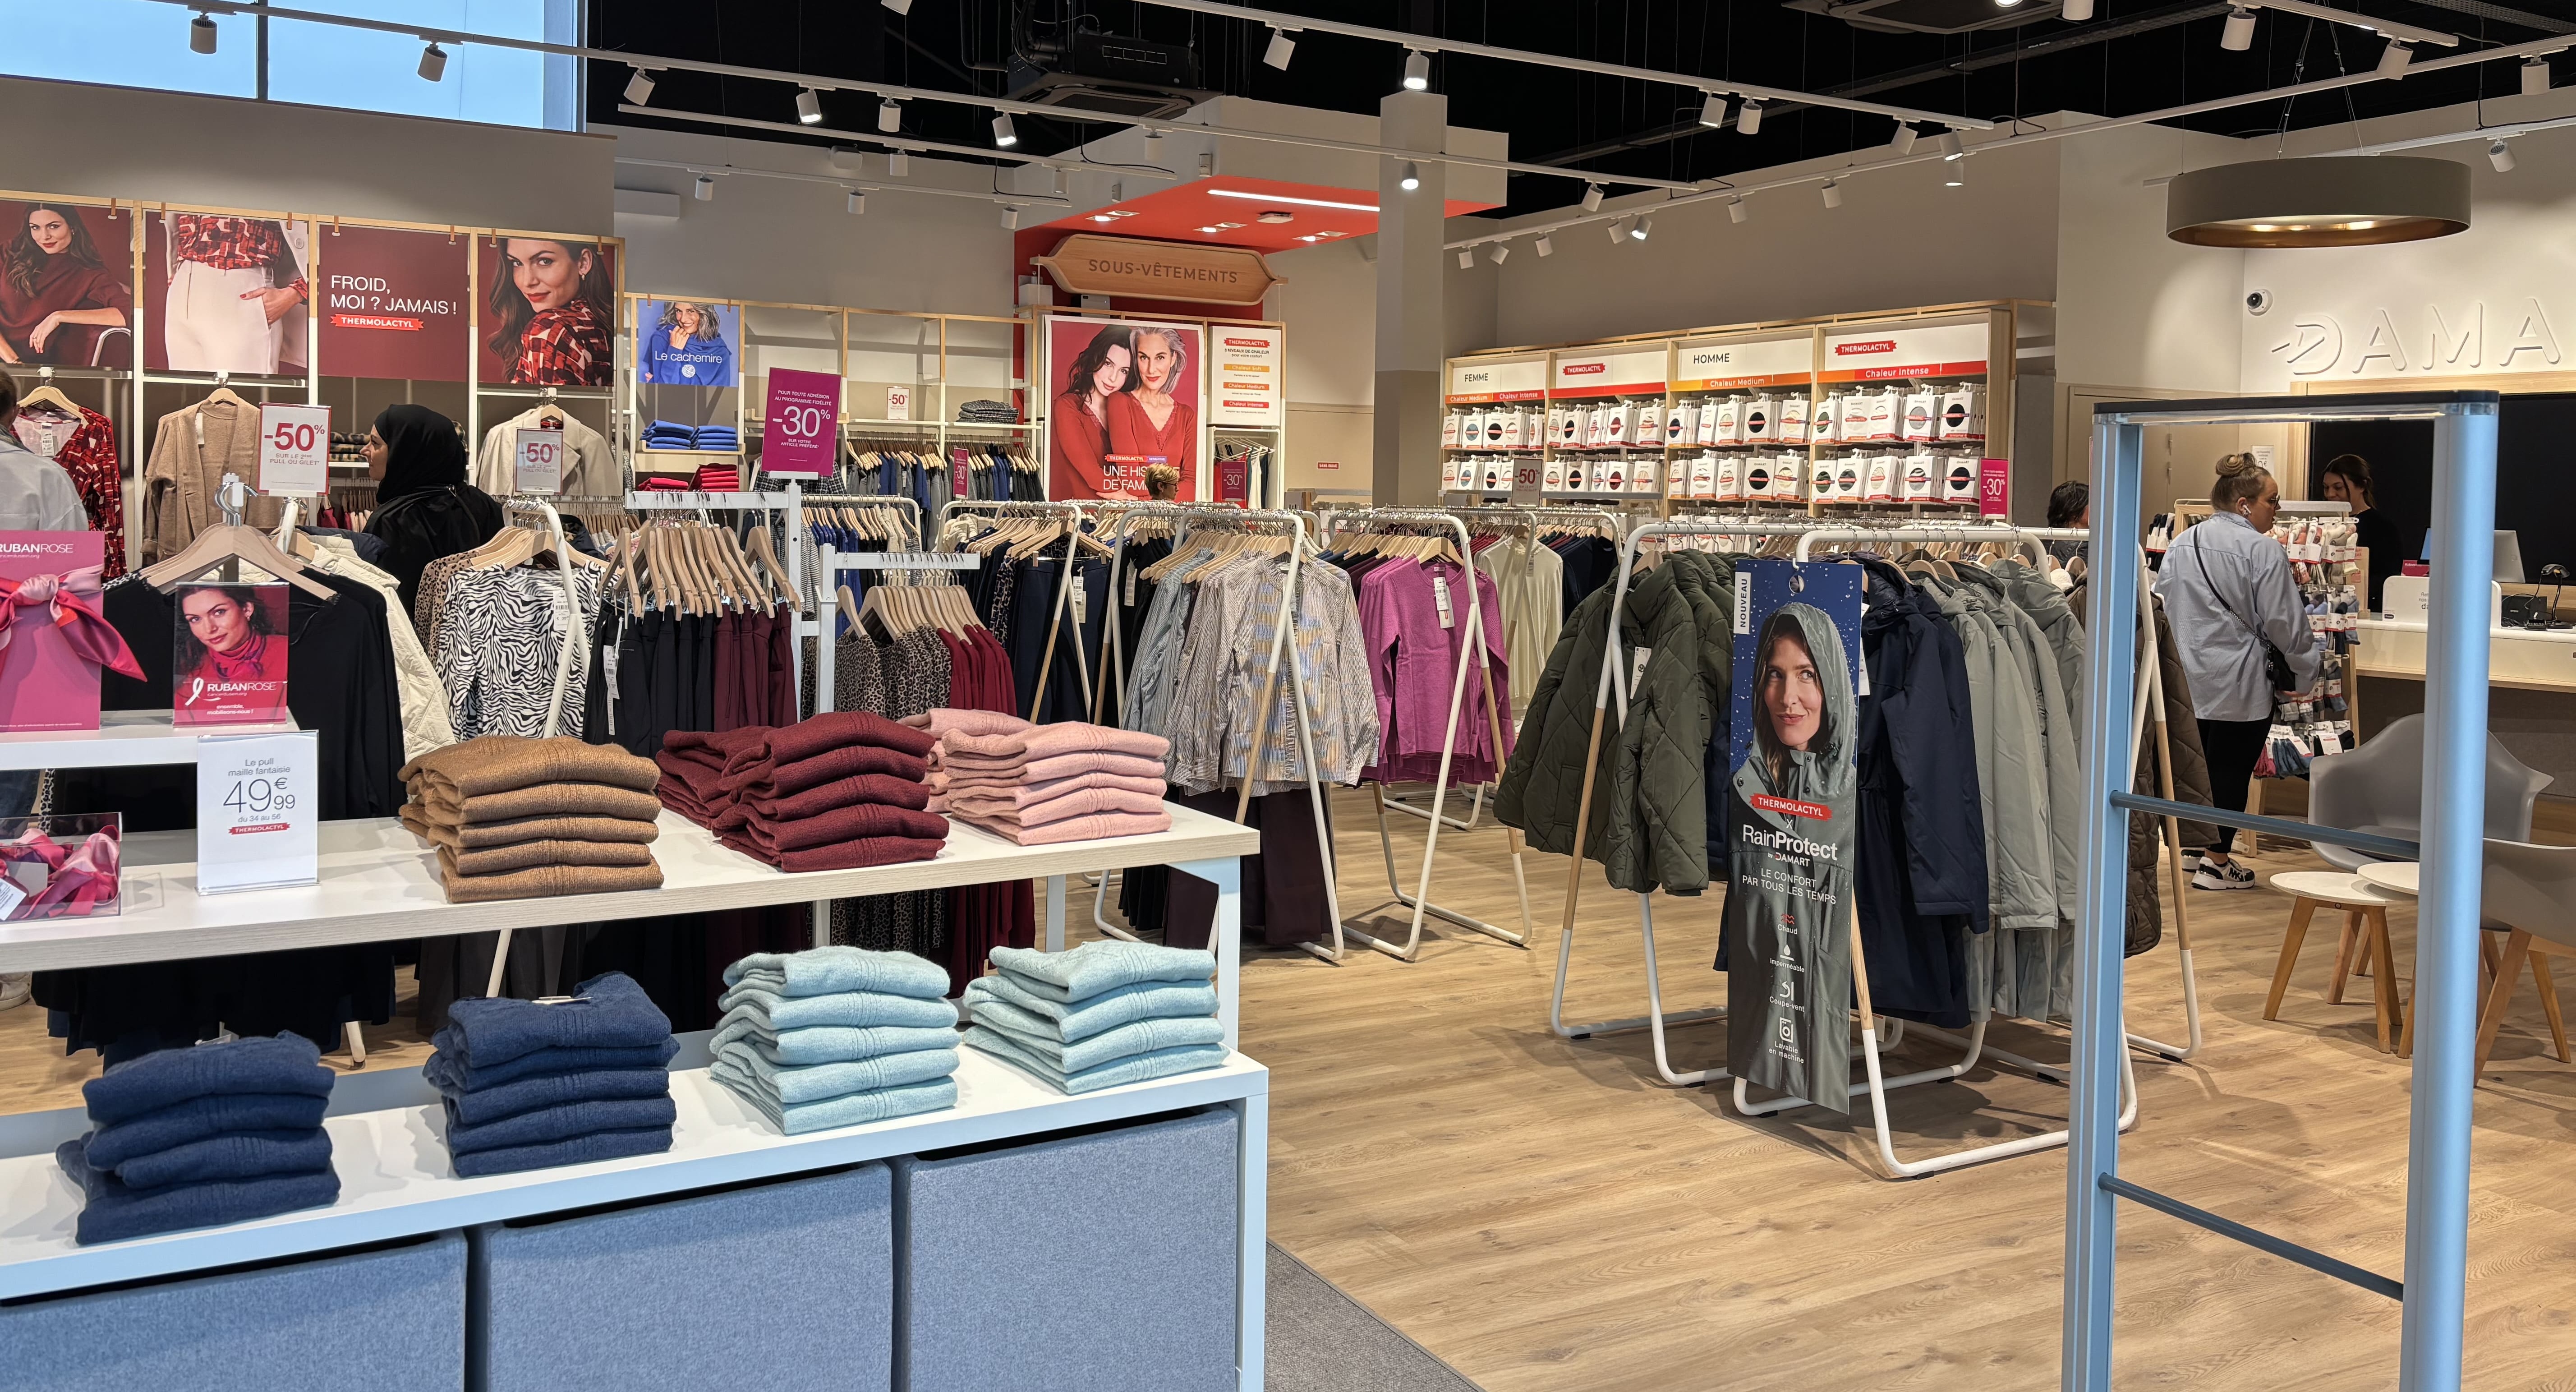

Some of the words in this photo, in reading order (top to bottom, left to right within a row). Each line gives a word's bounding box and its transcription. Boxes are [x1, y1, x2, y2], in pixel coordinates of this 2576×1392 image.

[1089, 259, 1237, 283] SOUS-VÊTEMENTS
[331, 275, 390, 294] FROID,
[331, 294, 364, 309] MOI
[371, 296, 380, 310] ?
[385, 298, 448, 314] JAMAIS
[453, 301, 456, 315] !
[341, 317, 414, 327] THERMOLACTYL
[1841, 343, 1890, 353] THERMOLACTYL
[655, 350, 667, 360] Le
[671, 353, 722, 364] cachemire
[1693, 353, 1730, 364] HOMME
[1465, 373, 1488, 382] FEMME
[1866, 369, 1896, 378] Chaleur
[1899, 368, 1929, 376] Intense
[1738, 378, 1764, 386] Medium
[773, 406, 831, 437] -30%
[264, 423, 325, 452] -50%
[520, 442, 560, 463] -50%
[1104, 466, 1127, 476] UNE
[1103, 479, 1119, 490] DE
[1983, 478, 2005, 496] -30%
[207, 682, 276, 692] RUBANROSE
[258, 758, 274, 767] pull
[228, 768, 253, 776] maille
[256, 766, 290, 775] fantaisie
[1758, 797, 1823, 816] THERMOLACTYL
[235, 824, 285, 833] THERMOLACTYL
[1743, 824, 1838, 861] RainProtect
[1775, 852, 1811, 867] DAMART
[1761, 868, 1771, 878] LE
[1774, 871, 1817, 888] CONFORT
[1743, 875, 1758, 887] PAR
[1761, 879, 1784, 892] TOUS
[1787, 885, 1803, 897] LES
[1806, 889, 1836, 904] TEMPS
[1778, 924, 1798, 935] Chaud
[1770, 957, 1804, 973] Imperméable
[1769, 996, 1805, 1012] Coupe-vent
[1775, 1041, 1799, 1054] Lavable
[1778, 1050, 1804, 1064] machine
